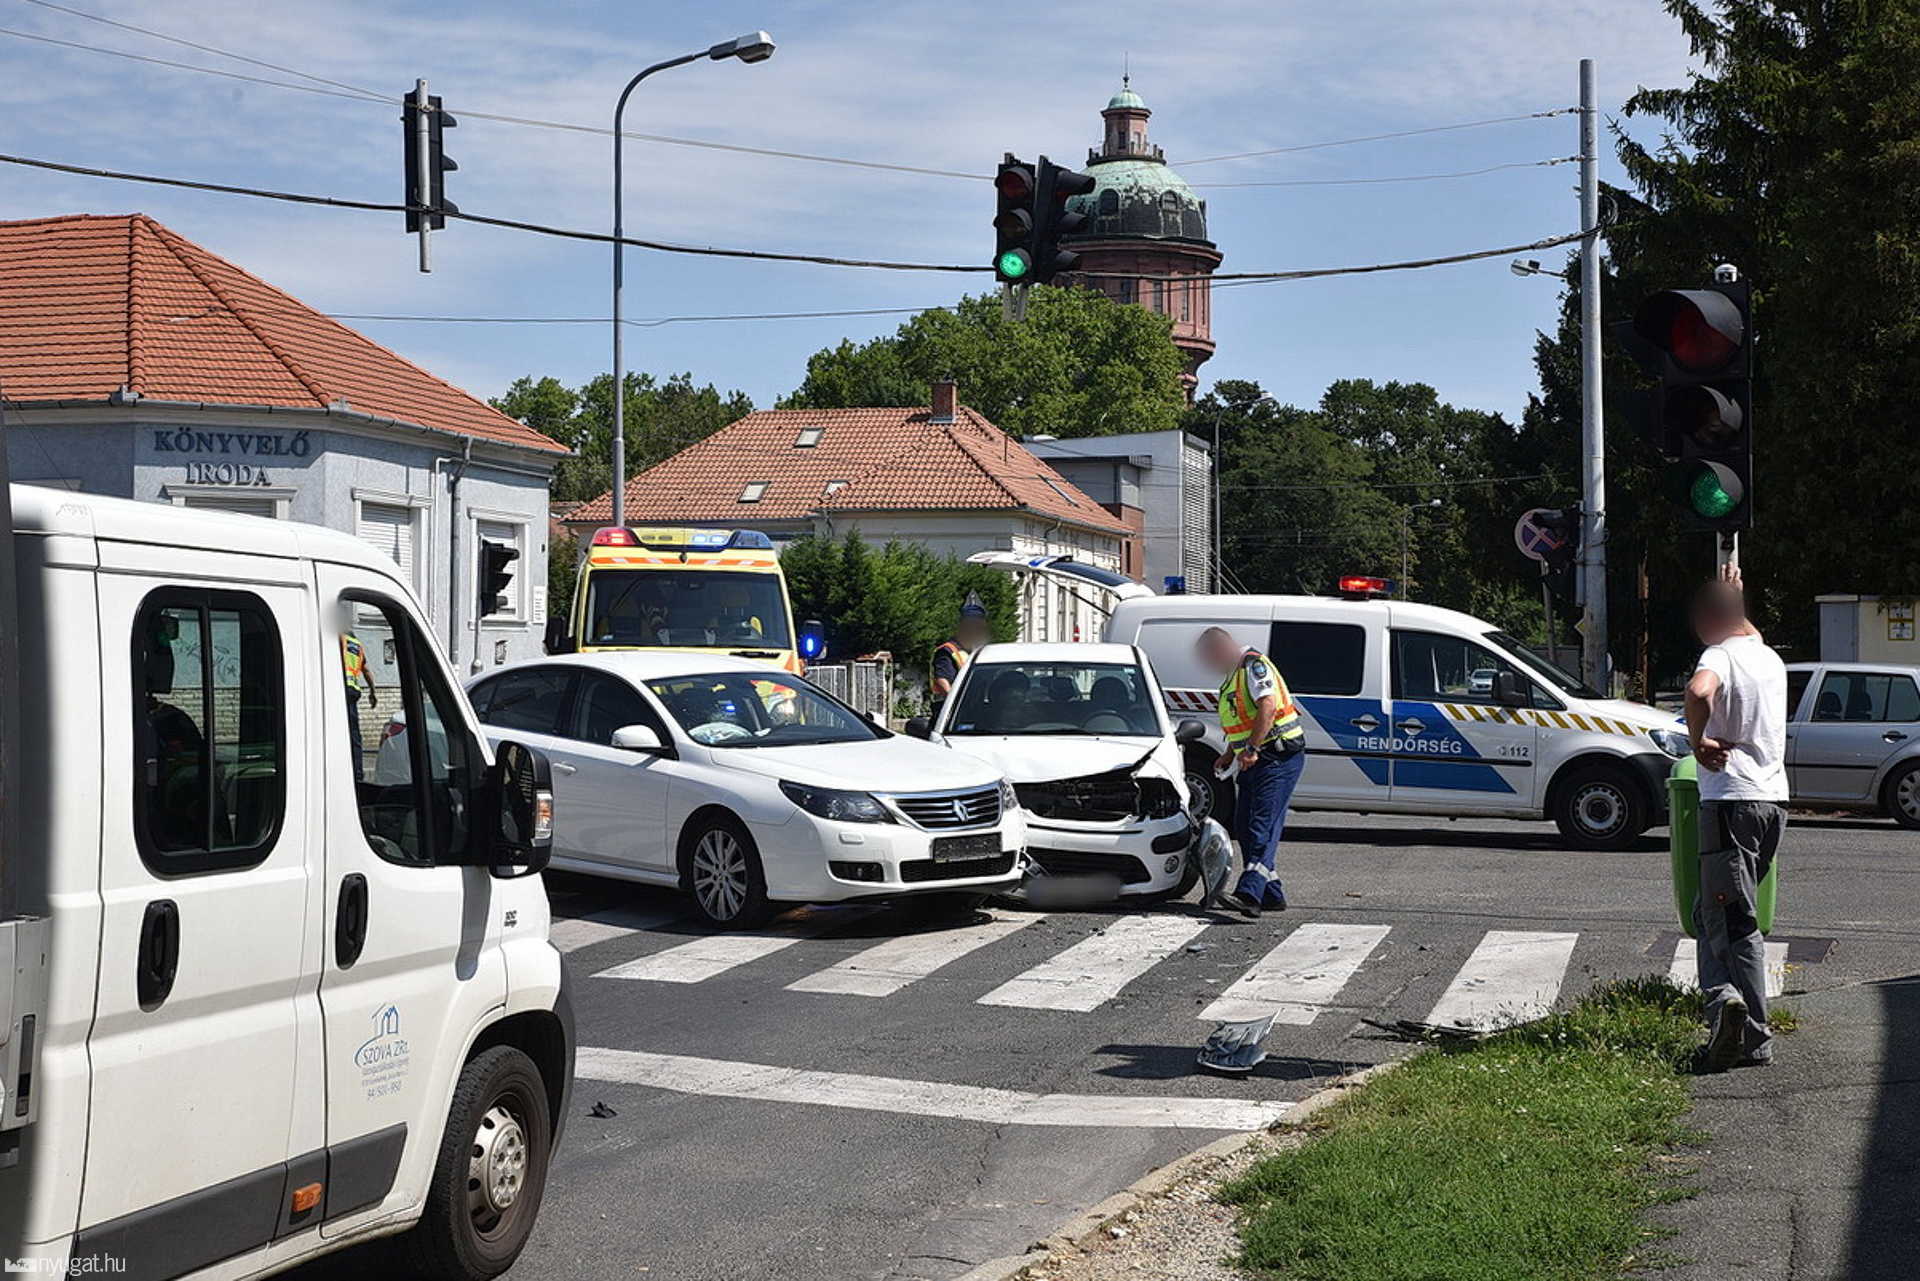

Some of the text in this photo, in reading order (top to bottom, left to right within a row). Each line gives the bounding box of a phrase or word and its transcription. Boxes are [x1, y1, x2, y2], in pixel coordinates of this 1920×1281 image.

[154, 427, 310, 457] KÖNYVELŐ
[185, 462, 272, 487] IRODA
[1357, 735, 1462, 754] RENDŐRSÉG
[1510, 746, 1528, 758] 112
[362, 1043, 392, 1065] SZOVA
